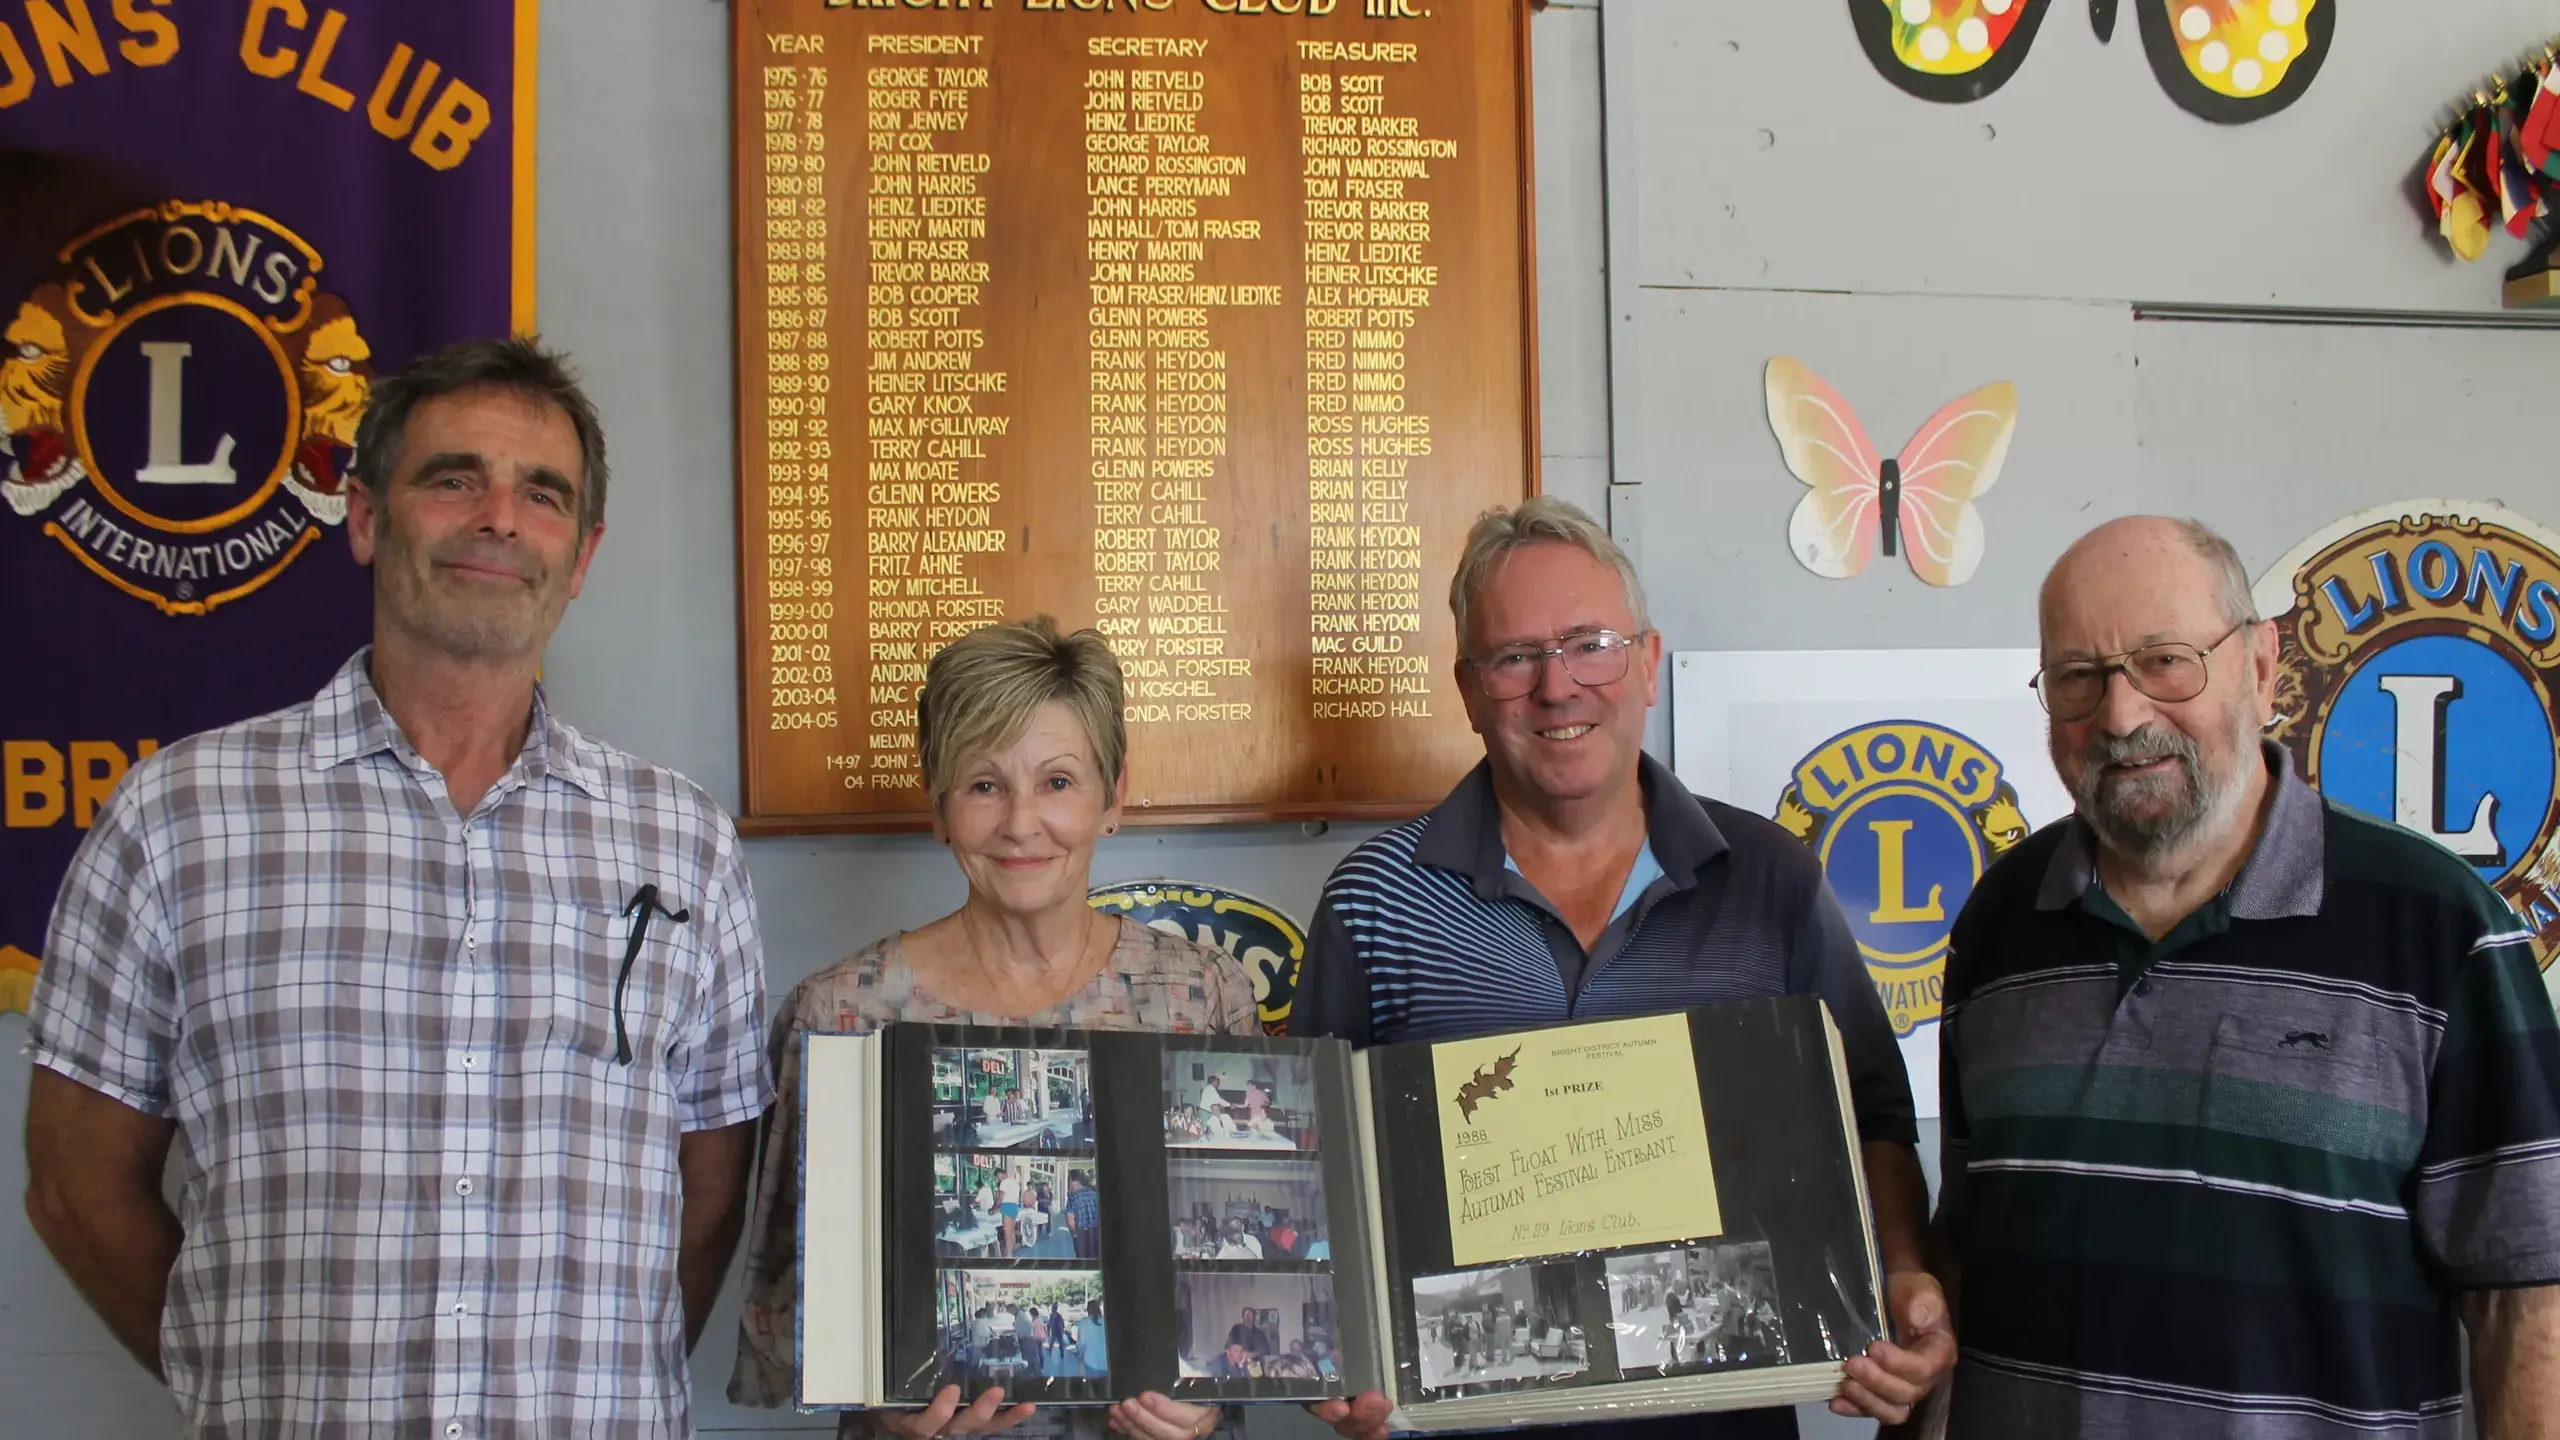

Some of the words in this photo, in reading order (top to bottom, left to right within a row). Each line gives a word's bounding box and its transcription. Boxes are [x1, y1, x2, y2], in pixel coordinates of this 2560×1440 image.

[767, 33, 825, 54] YEAR
[867, 34, 984, 55] PRESIDENT
[1087, 36, 1209, 58] SECRETARY
[1295, 40, 1418, 63] TREASURER
[240, 0, 491, 172] CLUB
[867, 66, 929, 88] GEORGE
[934, 66, 989, 89] TAYLOR
[1083, 68, 1125, 90] JOHN
[1131, 69, 1205, 91] RIETVELD
[1299, 72, 1333, 96] BOB
[1339, 73, 1385, 95] SCOTT
[867, 88, 922, 110] ROGER
[928, 88, 969, 110] FYFE
[1300, 93, 1332, 115] BOB
[1339, 94, 1385, 116] SCOTT
[868, 110, 902, 131] RON
[907, 110, 969, 131] JENVEY
[1085, 111, 1128, 133] HEINZ
[1134, 112, 1197, 134] LIEDTKE
[1084, 132, 1151, 154] GEORGE
[1153, 133, 1210, 155] TAYLOR
[1301, 136, 1362, 160] RICHARD
[1366, 136, 1458, 160] ROSSINGTON
[868, 152, 912, 174] JOHN
[916, 152, 992, 174] RIETVELD
[1302, 157, 1342, 178] JOHN
[1344, 157, 1430, 179] VANDERWAL
[868, 173, 913, 196] JOHN
[917, 173, 977, 196] HARRIS
[1086, 174, 1139, 197] LANCE
[1145, 175, 1231, 197] PERRYMAN
[1087, 196, 1133, 218] JOHN
[1137, 196, 1198, 219] HARRIS
[1304, 198, 1364, 222] TREVOR
[1369, 199, 1430, 222] BARKER
[868, 217, 923, 239] HENRY
[927, 217, 986, 239] MARTIN
[1304, 219, 1365, 241] TREVOR
[1369, 221, 1431, 242] BARKER
[869, 239, 903, 261] TOM
[907, 239, 969, 261] FRASER
[1087, 239, 1140, 262] HENRY
[1146, 239, 1204, 262] MARTIN
[84, 225, 299, 304] LIONS
[1089, 260, 1133, 283] JOHN
[1137, 262, 1196, 284] HARRIS
[1305, 263, 1362, 285] HEINER
[1364, 264, 1439, 286] LITSCHKE
[867, 283, 905, 306] BOB
[909, 283, 980, 306] COOPER
[1305, 285, 1342, 307] ALEX
[1347, 285, 1430, 307] HOFBAUER
[867, 307, 904, 328] BOB
[908, 306, 961, 328] SCOTT
[1088, 306, 1142, 328] GLENN
[1146, 306, 1209, 328] POWERS
[1089, 327, 1142, 349] GLENN
[1146, 327, 1210, 349] POWERS
[1306, 328, 1346, 349] FRED
[1352, 329, 1405, 350] NIMMO
[867, 350, 897, 372] JIM
[902, 349, 972, 371] ANDREW
[1306, 350, 1346, 371] FRED
[1352, 350, 1406, 371] NIMMO
[868, 372, 927, 394] HEINER
[932, 371, 1008, 393] LITSCHKE
[1090, 370, 1147, 393] FRANK
[1155, 371, 1227, 392] HEYDON
[136, 342, 237, 484] L
[1090, 392, 1148, 414] FRANK
[1155, 393, 1227, 413] HEYDON
[1307, 393, 1348, 413] FRED
[1352, 393, 1405, 413] NIMMO
[1307, 414, 1354, 434] ROSS
[1361, 415, 1430, 435] HUGHES
[869, 437, 923, 460] TERRY
[926, 437, 987, 459] CAHILL
[1091, 436, 1147, 458] FRANK
[1155, 436, 1226, 457] HEYDON
[1091, 458, 1145, 479] GLENN
[1151, 458, 1215, 479] POWERS
[1309, 457, 1354, 478] BRIAN
[1361, 457, 1408, 478] KELLY
[867, 482, 925, 505] GLENN
[930, 481, 1001, 504] POWERS
[1309, 478, 1354, 501] BRIAN
[1361, 479, 1408, 501] KELLY
[867, 506, 921, 529] FRANK
[925, 505, 990, 528] HEYDON
[1094, 503, 1144, 526] TERRY
[1150, 503, 1206, 525] CAHILL
[59, 498, 307, 580] INTERNATIONAL
[1094, 526, 1156, 551] ROBERT
[1163, 527, 1221, 550] TAYLOR
[1310, 525, 1356, 548] FRANK
[1359, 525, 1421, 548] HEYDON
[868, 554, 912, 577] FRITZ
[918, 551, 964, 576] AHNE
[1310, 548, 1357, 572] FRANK
[1359, 548, 1421, 570] HEYDON
[868, 577, 901, 597] ROY
[905, 576, 984, 597] MITCHELL
[1095, 574, 1145, 593] TERRY
[1148, 573, 1208, 592] CAHILL
[2320, 540, 2560, 643] LIONS
[868, 599, 932, 619] RHONDA
[935, 598, 1005, 618] FORSTER
[1094, 595, 1141, 615] GARY
[1147, 594, 1229, 614] WADDELL
[1310, 591, 1356, 613] FRANK
[1360, 591, 1419, 611] HEYDON
[1095, 616, 1142, 636] GARY
[1147, 615, 1228, 635] WADDELL
[1310, 611, 1359, 634] FRANK
[1362, 612, 1421, 633] HEYDON
[1312, 654, 1364, 676] FRANK
[1367, 655, 1429, 675] HEYDON
[1311, 676, 1385, 695] RICHARD
[1389, 676, 1431, 695] HALL
[1313, 699, 1386, 719] RICHARD
[1390, 699, 1433, 718] HALL
[1811, 733, 1988, 801] LIONS
[2378, 674, 2502, 856] L
[1868, 819, 1945, 924] L
[1551, 1047, 1581, 1057] BRIGHT
[1583, 1042, 1620, 1053] DISTRICT
[1622, 1038, 1657, 1048] AUTUMN
[1586, 1050, 1624, 1059] FESTIVAL
[982, 1059, 1005, 1075] DELI
[1544, 1087, 1559, 1097] 1st
[1563, 1081, 1604, 1094] PRIZE
[1457, 1129, 1488, 1145] 1988
[973, 1153, 993, 1169] DELI
[1559, 1219, 1595, 1235] Lions
